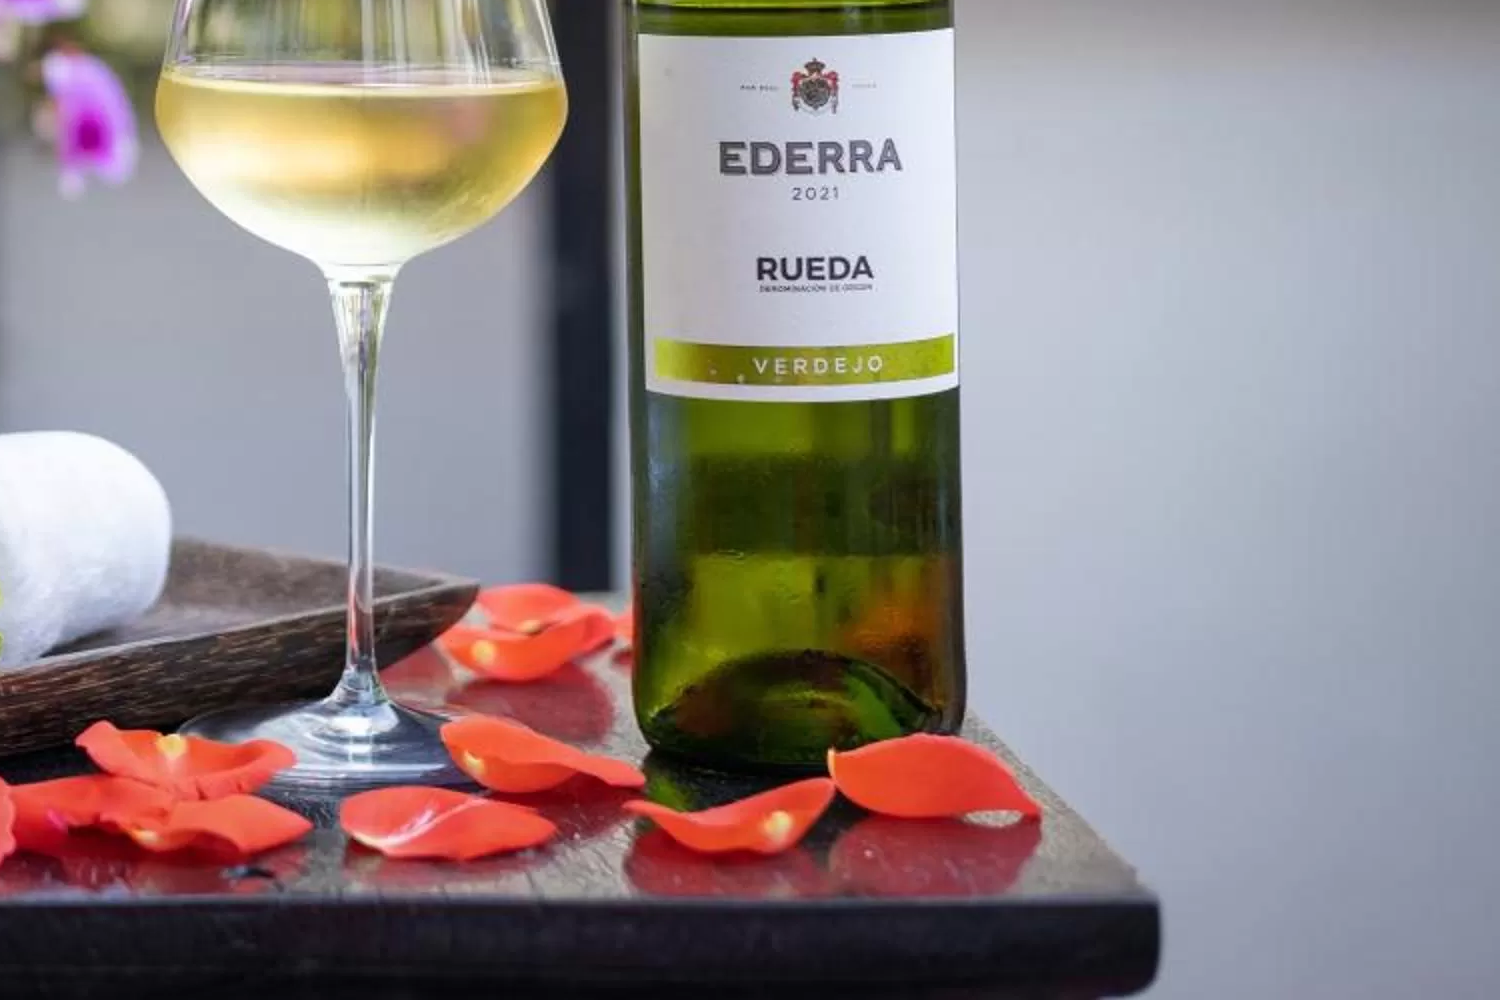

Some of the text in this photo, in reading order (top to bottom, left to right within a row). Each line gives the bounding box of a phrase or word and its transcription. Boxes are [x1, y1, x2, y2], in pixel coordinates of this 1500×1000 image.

[718, 138, 903, 175] EDERRA
[792, 186, 839, 201] 2021
[756, 256, 874, 281] RUEDA
[752, 355, 883, 375] VERDEJO
